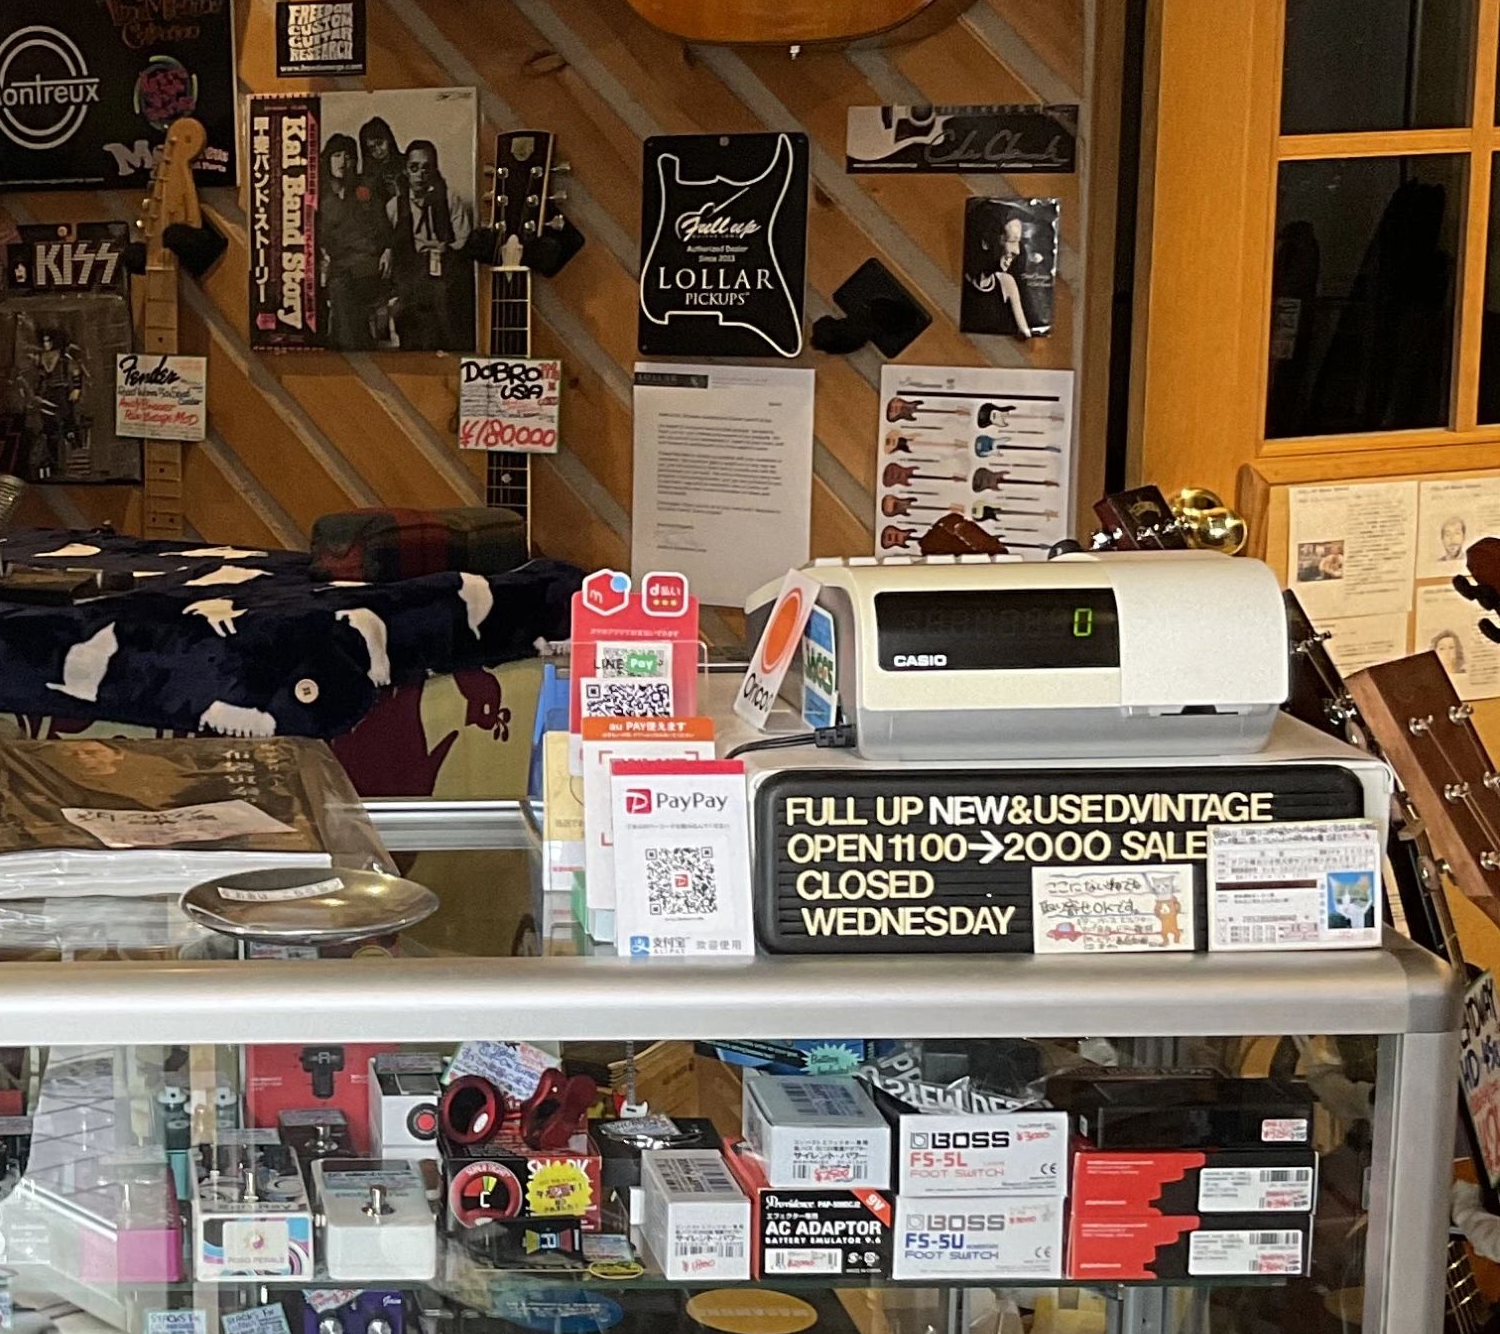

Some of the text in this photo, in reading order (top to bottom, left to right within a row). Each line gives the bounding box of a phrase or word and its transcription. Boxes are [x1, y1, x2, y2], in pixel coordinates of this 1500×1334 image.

[289, 42, 354, 62] RESEARCH
[280, 173, 307, 248] Band
[35, 241, 122, 286] KISS
[658, 266, 774, 290] LOLLAR
[277, 250, 306, 330] Story
[685, 292, 746, 306] PICKUPS
[1073, 607, 1092, 637] 0
[630, 657, 655, 672] Pay
[892, 654, 948, 667] CASIO
[655, 791, 728, 813] PayPay
[784, 796, 868, 827] FULL
[874, 796, 925, 826] UP
[787, 832, 883, 864] OPEN
[795, 869, 935, 901] CLOSED
[801, 905, 1016, 937] WEDNESDAY
[931, 1131, 1010, 1149] BOSS
[910, 1151, 968, 1168] FS-5L
[910, 1168, 1005, 1178] FOOT SWITCH
[765, 1220, 882, 1236] AC ADAPTOR
[927, 1214, 1005, 1231] BOSS
[905, 1232, 964, 1249] FS-5U
[905, 1250, 999, 1260] FOOT SWITCH
